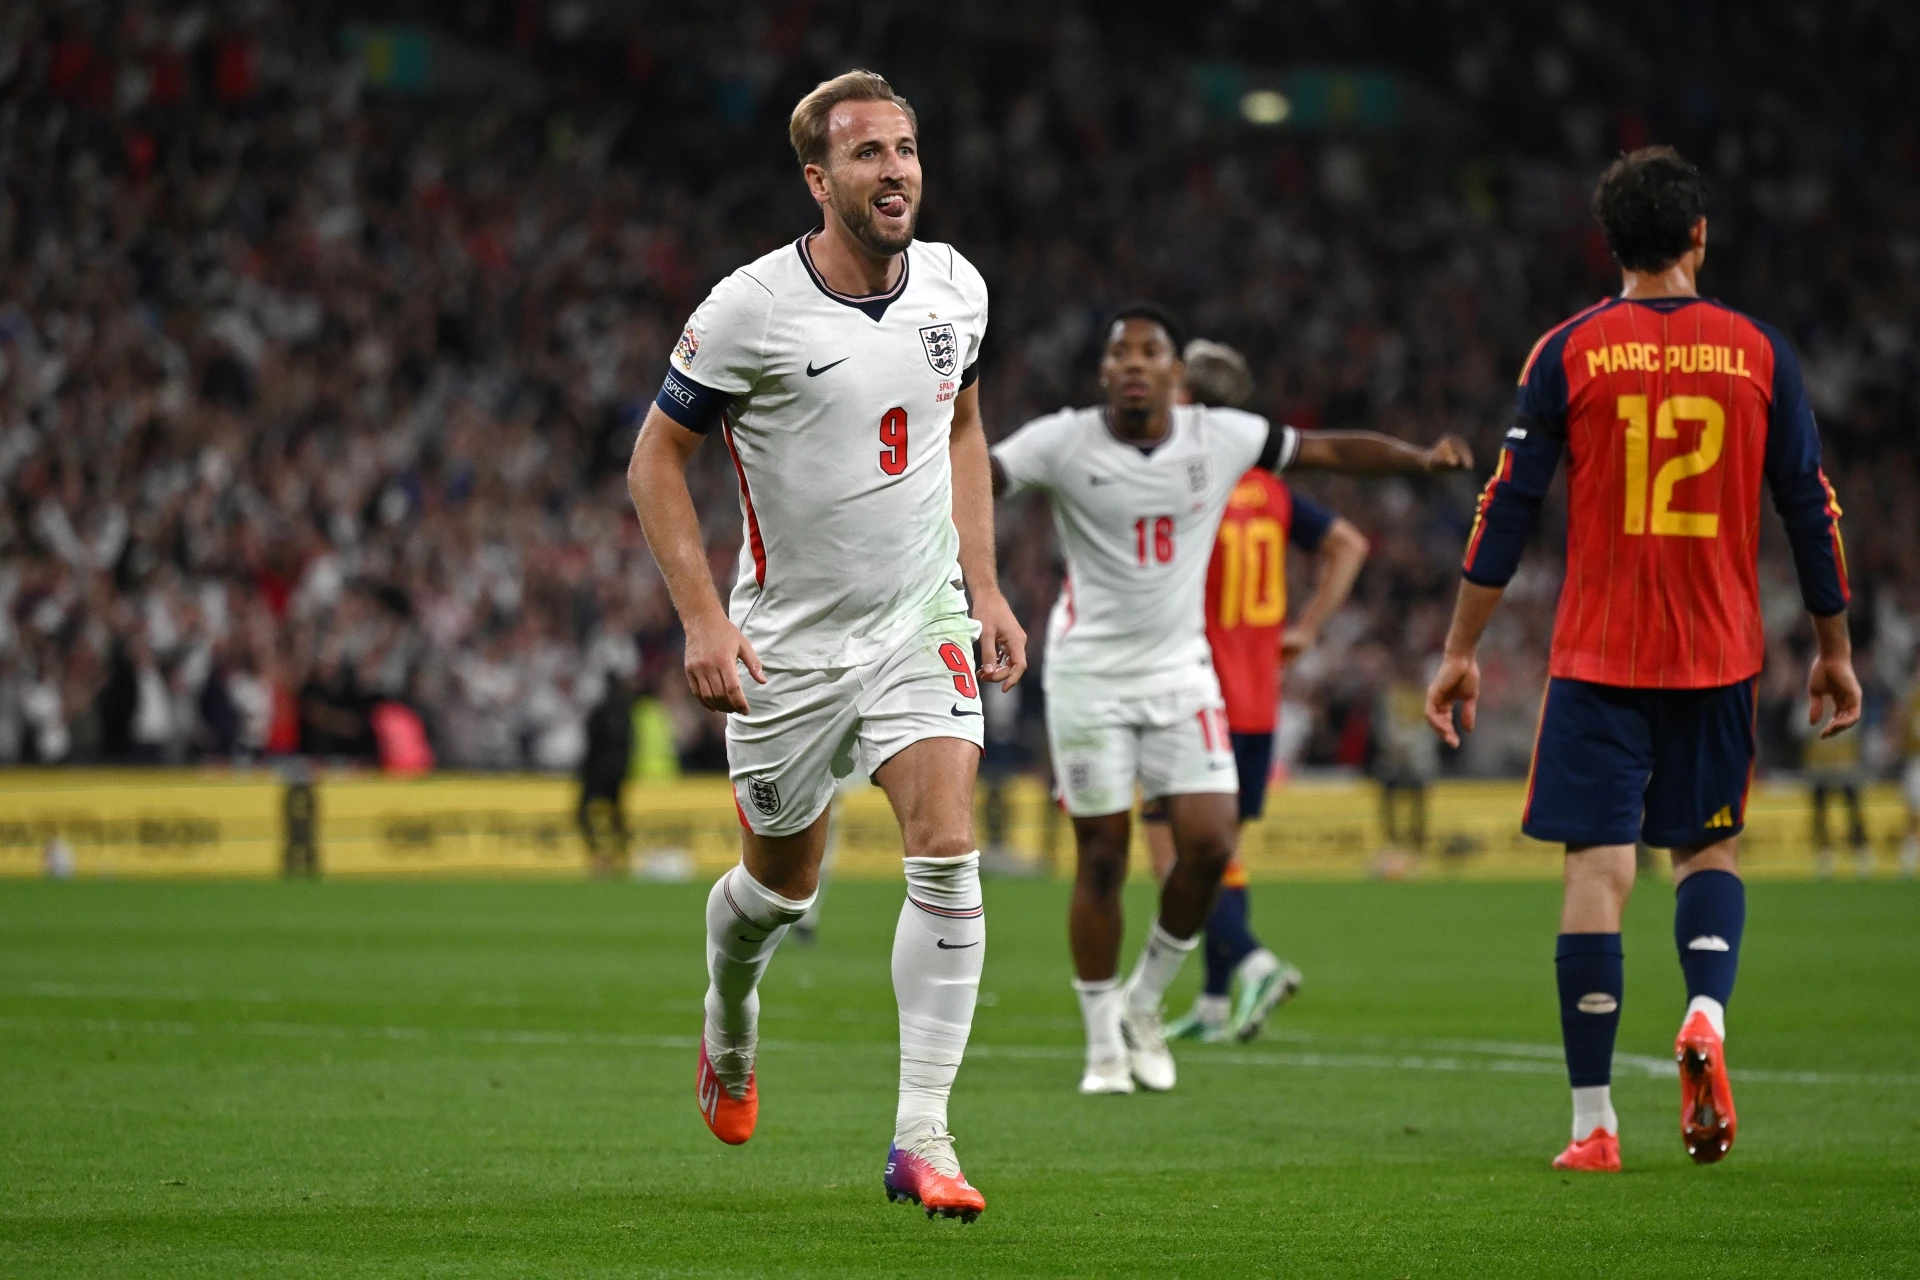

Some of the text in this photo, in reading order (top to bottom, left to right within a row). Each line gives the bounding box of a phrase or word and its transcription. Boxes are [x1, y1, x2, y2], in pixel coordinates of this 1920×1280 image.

[939, 381, 955, 392] SPAIN
[1586, 342, 1751, 378] MARC PUBILL
[879, 406, 908, 476] 9
[1617, 394, 1725, 538] 12
[1134, 515, 1175, 568] 16
[1219, 516, 1288, 631] 10
[938, 642, 978, 700] 9
